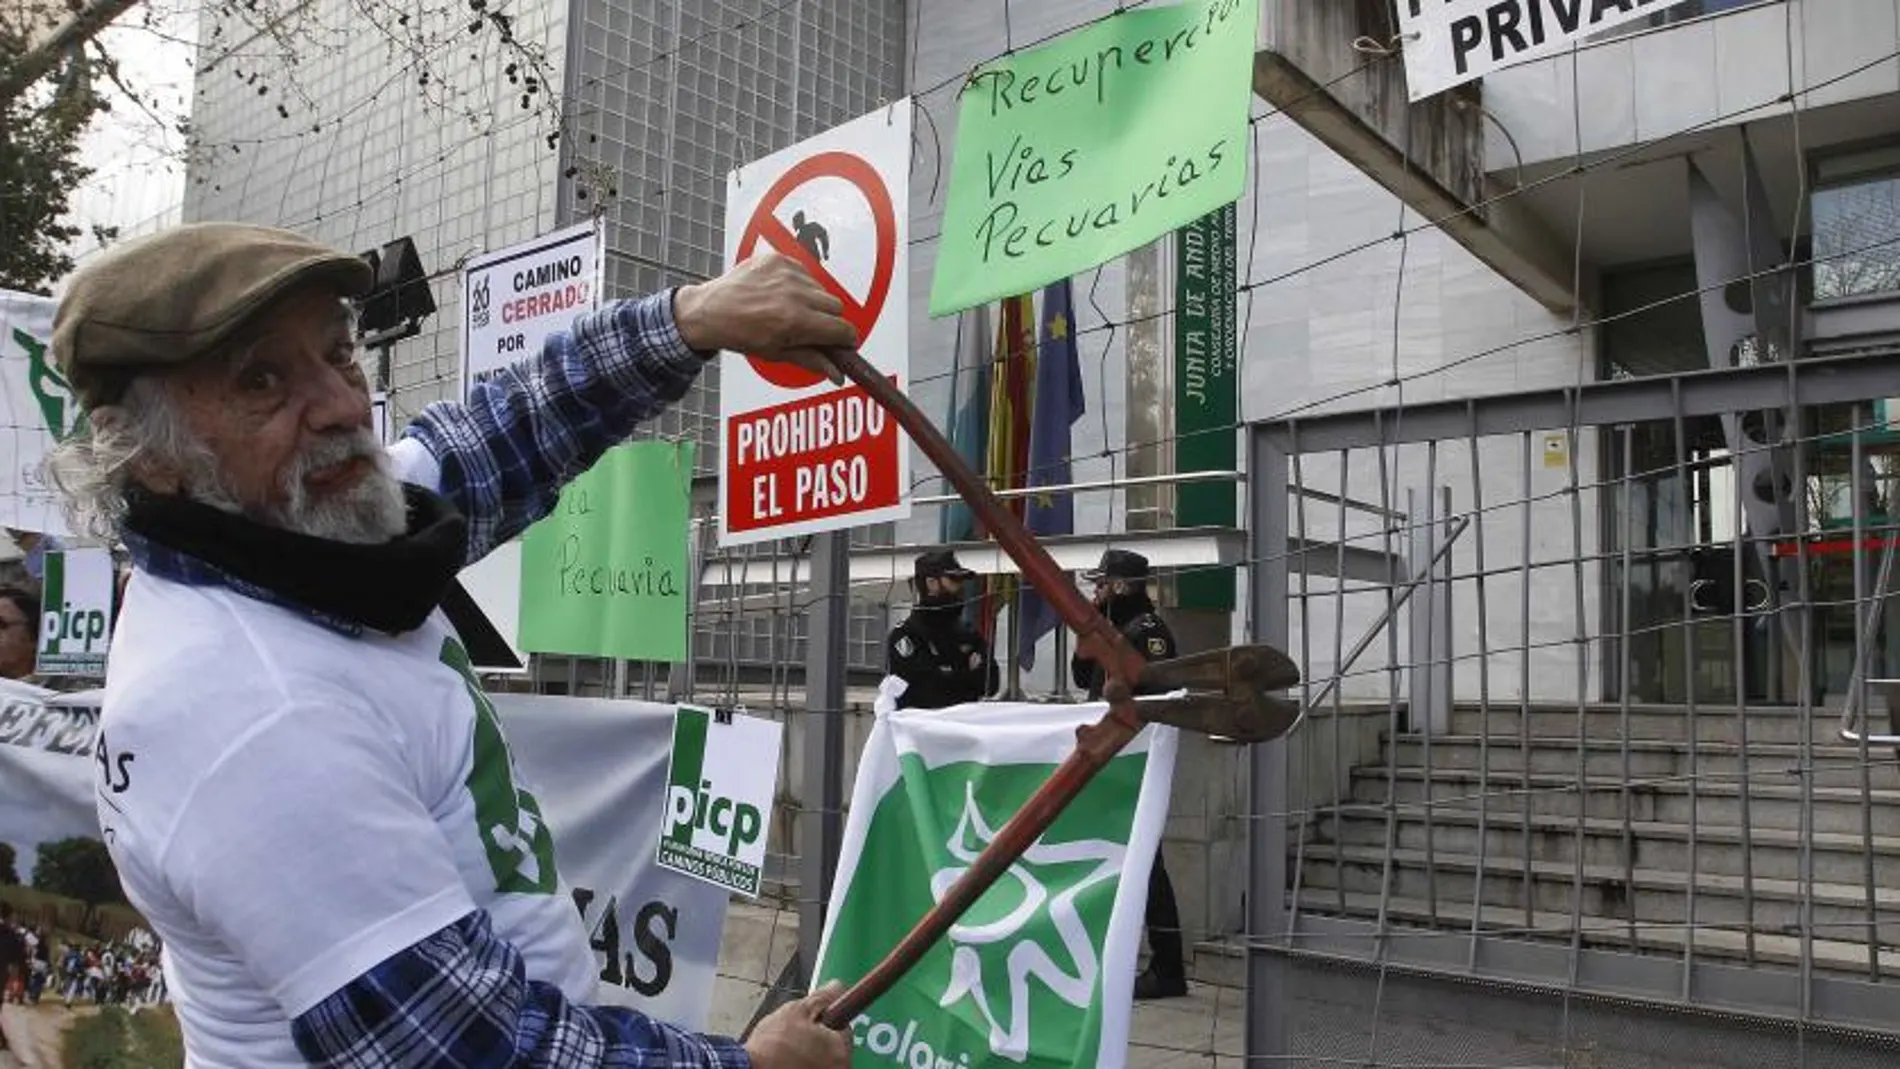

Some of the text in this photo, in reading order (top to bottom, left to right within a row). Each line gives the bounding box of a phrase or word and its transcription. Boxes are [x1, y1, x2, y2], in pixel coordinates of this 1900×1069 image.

[975, 140, 1227, 263] Pecuarias
[502, 281, 590, 324] CERRADO
[513, 256, 582, 292] CAMINO
[497, 333, 525, 354] POR
[1186, 331, 1206, 405] JUNTA
[737, 395, 885, 466] PROHIBIDO
[753, 455, 868, 520] EL PASO
[44, 601, 105, 655] picp
[663, 778, 762, 857] picp
